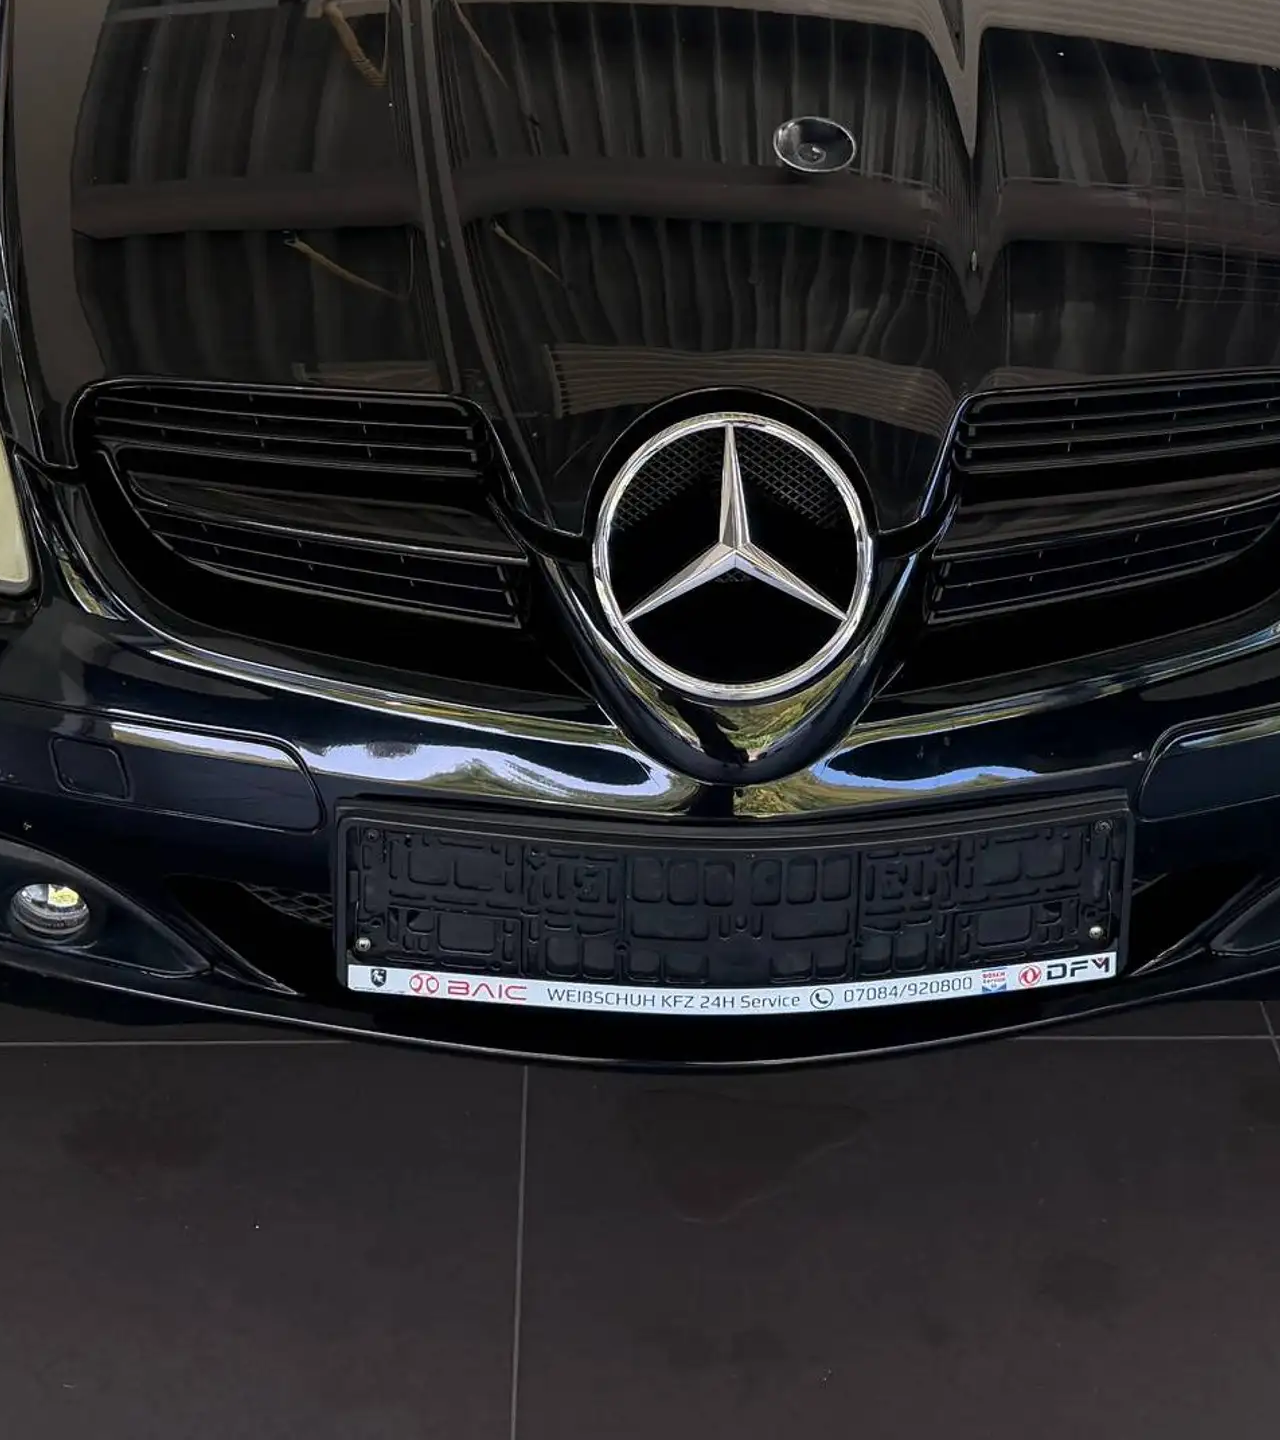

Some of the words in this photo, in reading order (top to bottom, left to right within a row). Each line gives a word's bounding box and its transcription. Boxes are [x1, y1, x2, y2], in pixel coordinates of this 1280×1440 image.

[447, 979, 528, 1001] BAIC
[661, 994, 695, 1009] KFZ
[700, 995, 736, 1009] 24H
[740, 994, 801, 1009] Service
[843, 977, 973, 1003] 07084/920800
